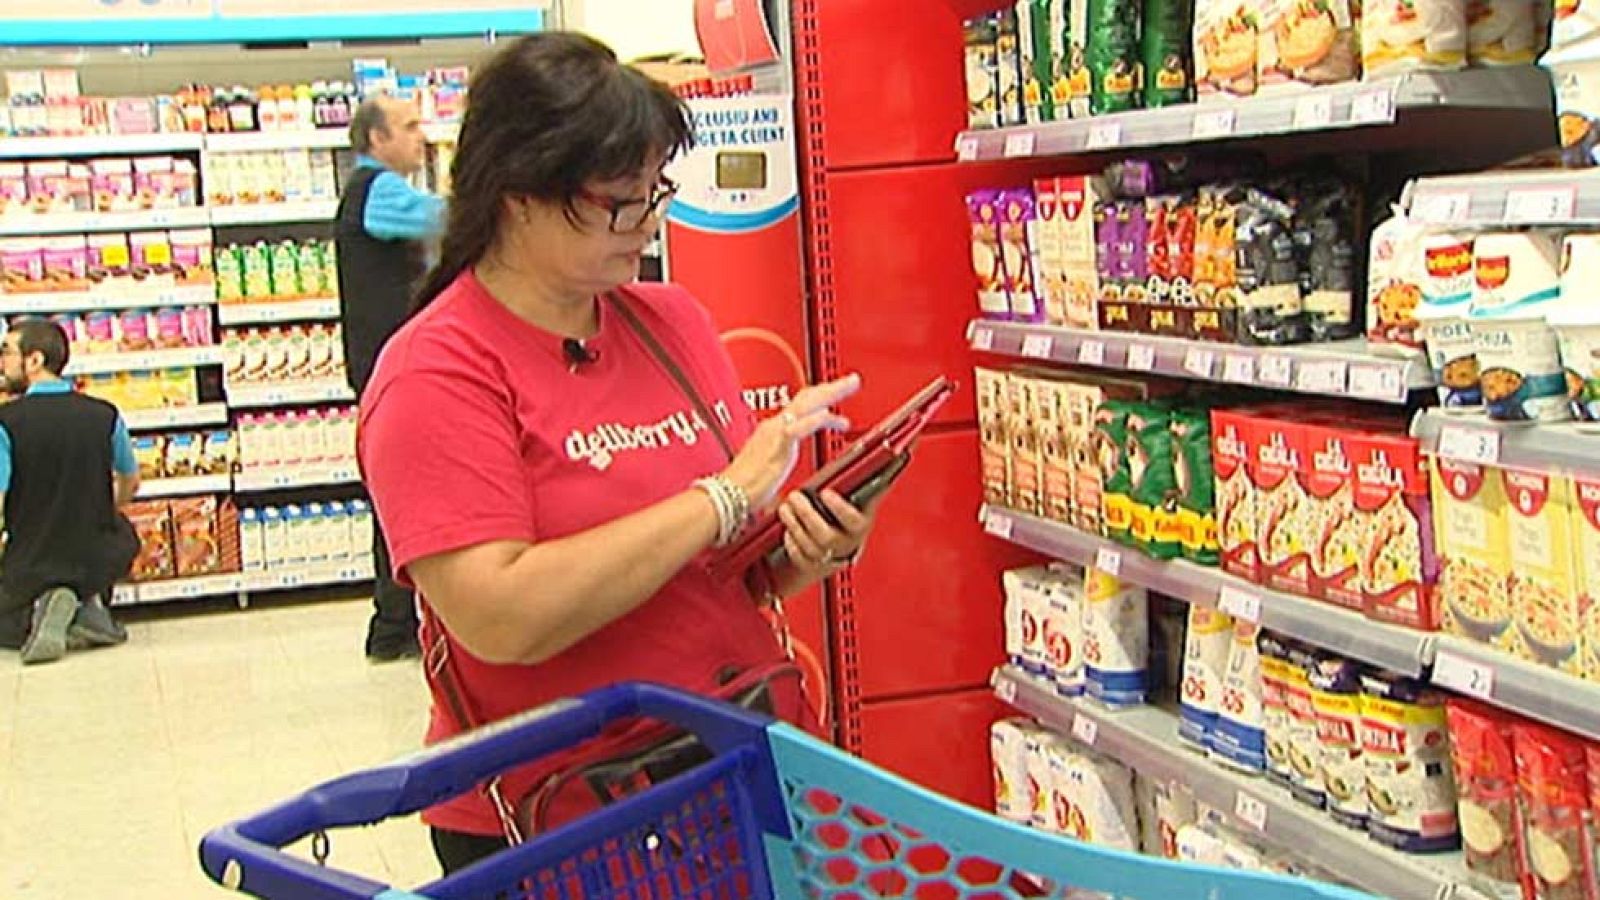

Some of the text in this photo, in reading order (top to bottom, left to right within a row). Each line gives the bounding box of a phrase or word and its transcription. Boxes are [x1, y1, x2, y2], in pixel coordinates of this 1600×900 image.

[695, 110, 749, 127] CLUSIU
[695, 129, 738, 146] GETA
[742, 385, 791, 410] RTES
[564, 399, 733, 470] deliberry.
